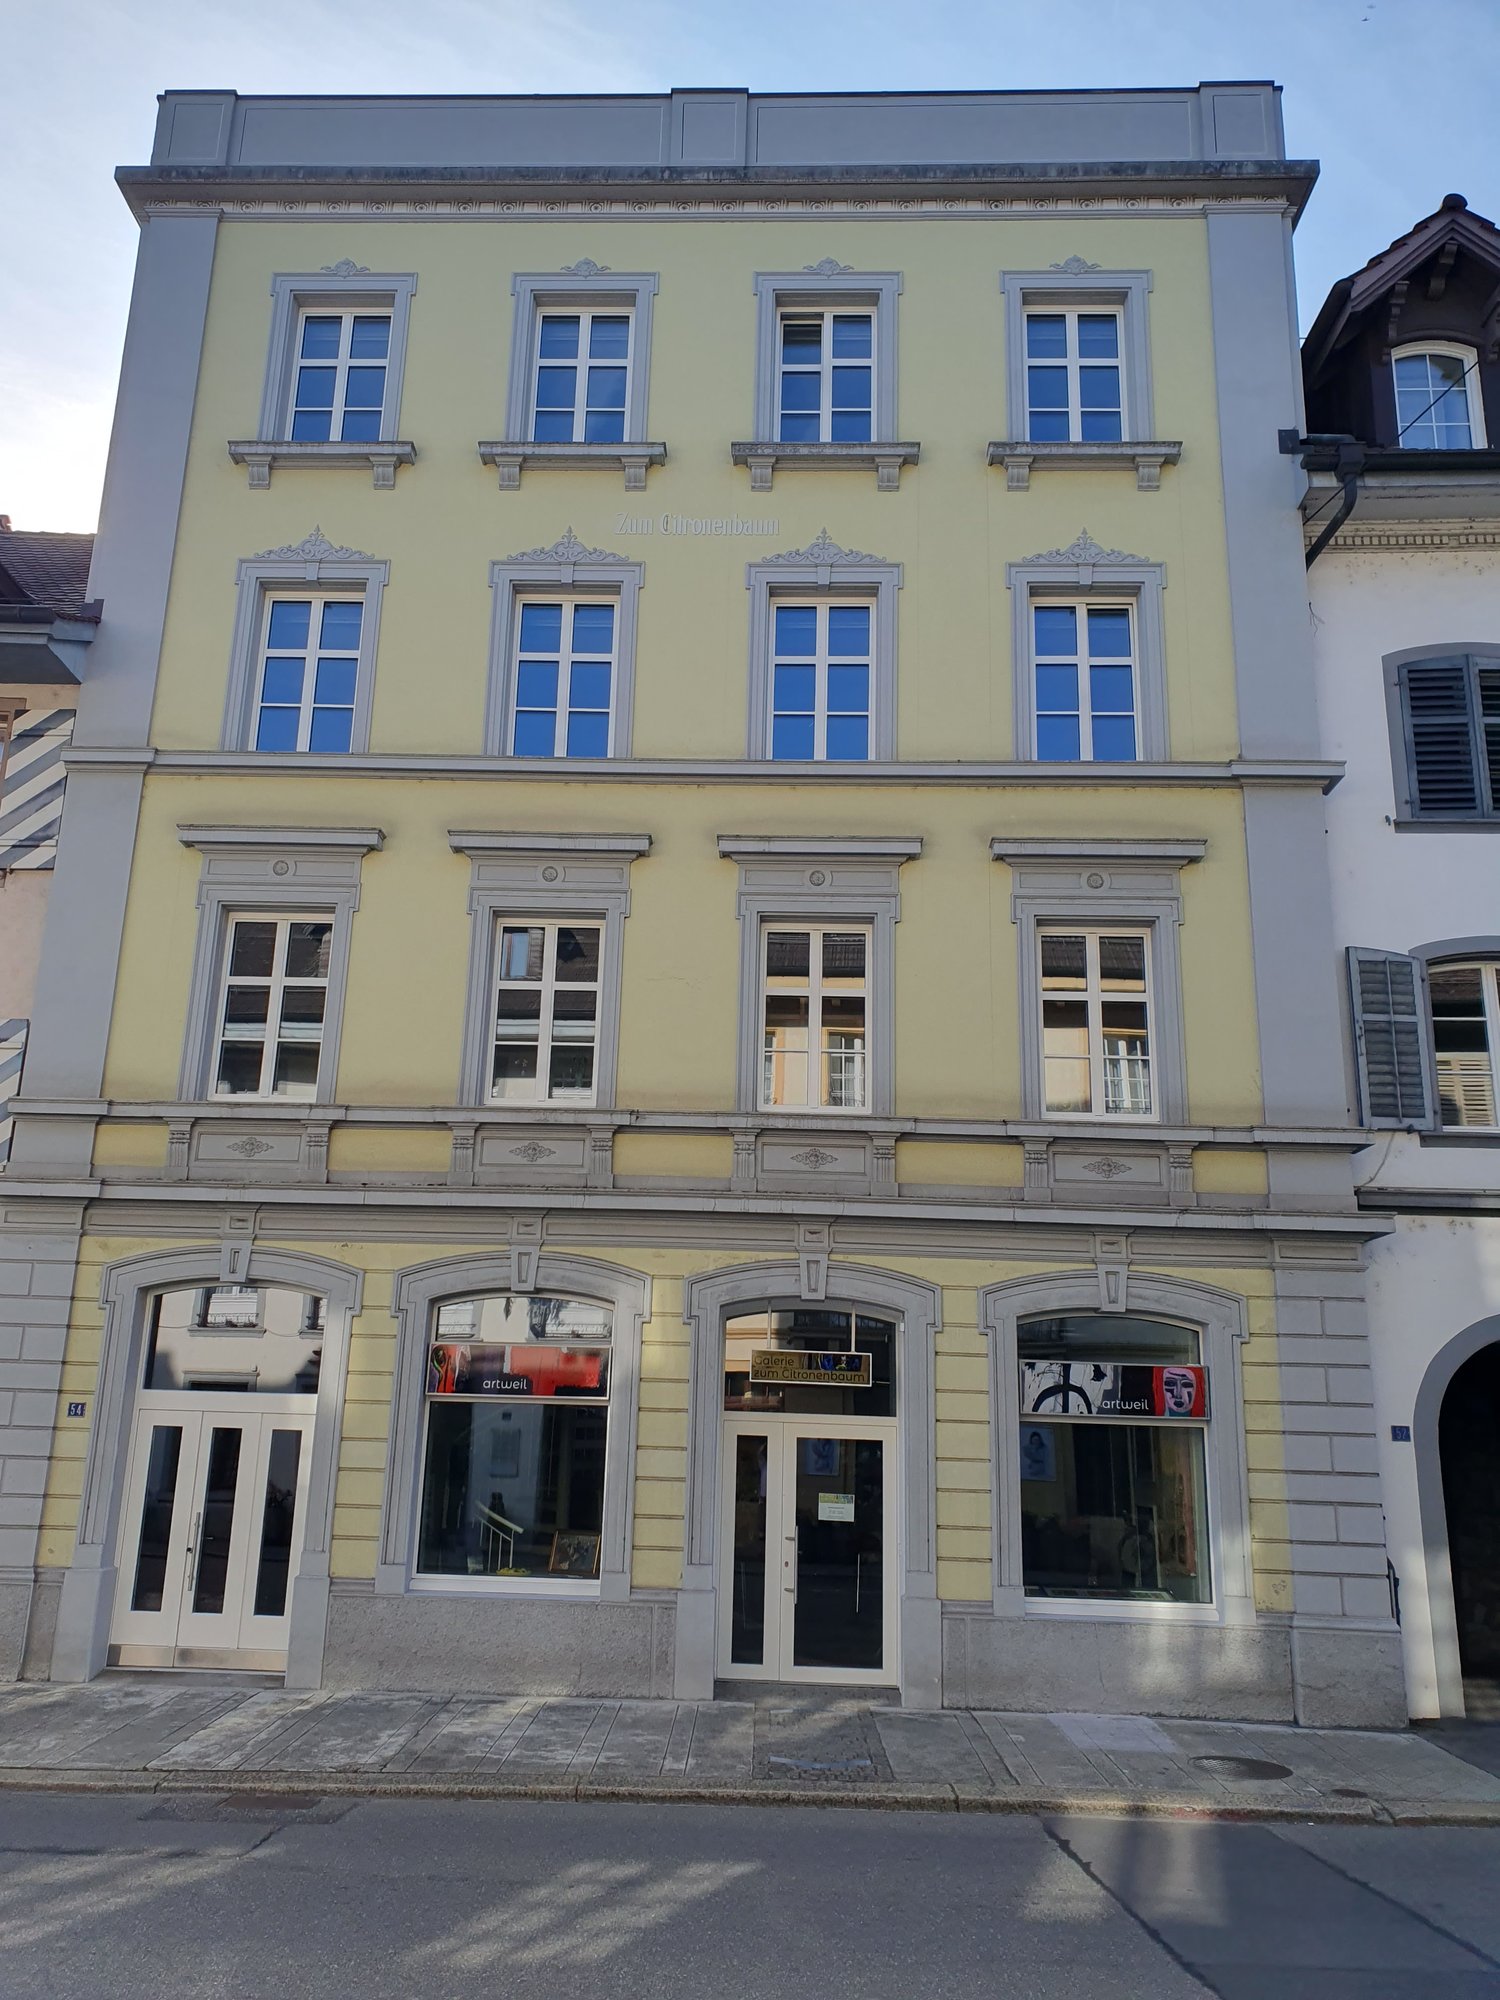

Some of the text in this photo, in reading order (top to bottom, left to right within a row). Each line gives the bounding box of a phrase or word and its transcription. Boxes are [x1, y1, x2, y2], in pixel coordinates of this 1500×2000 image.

[614, 512, 780, 536] Zum Citronenbaum
[754, 1355, 795, 1367] Galerie
[754, 1368, 865, 1382] zum Citronenbaum
[482, 1378, 528, 1390] artweil
[70, 1403, 82, 1416] 54
[1102, 1398, 1149, 1410] artweil
